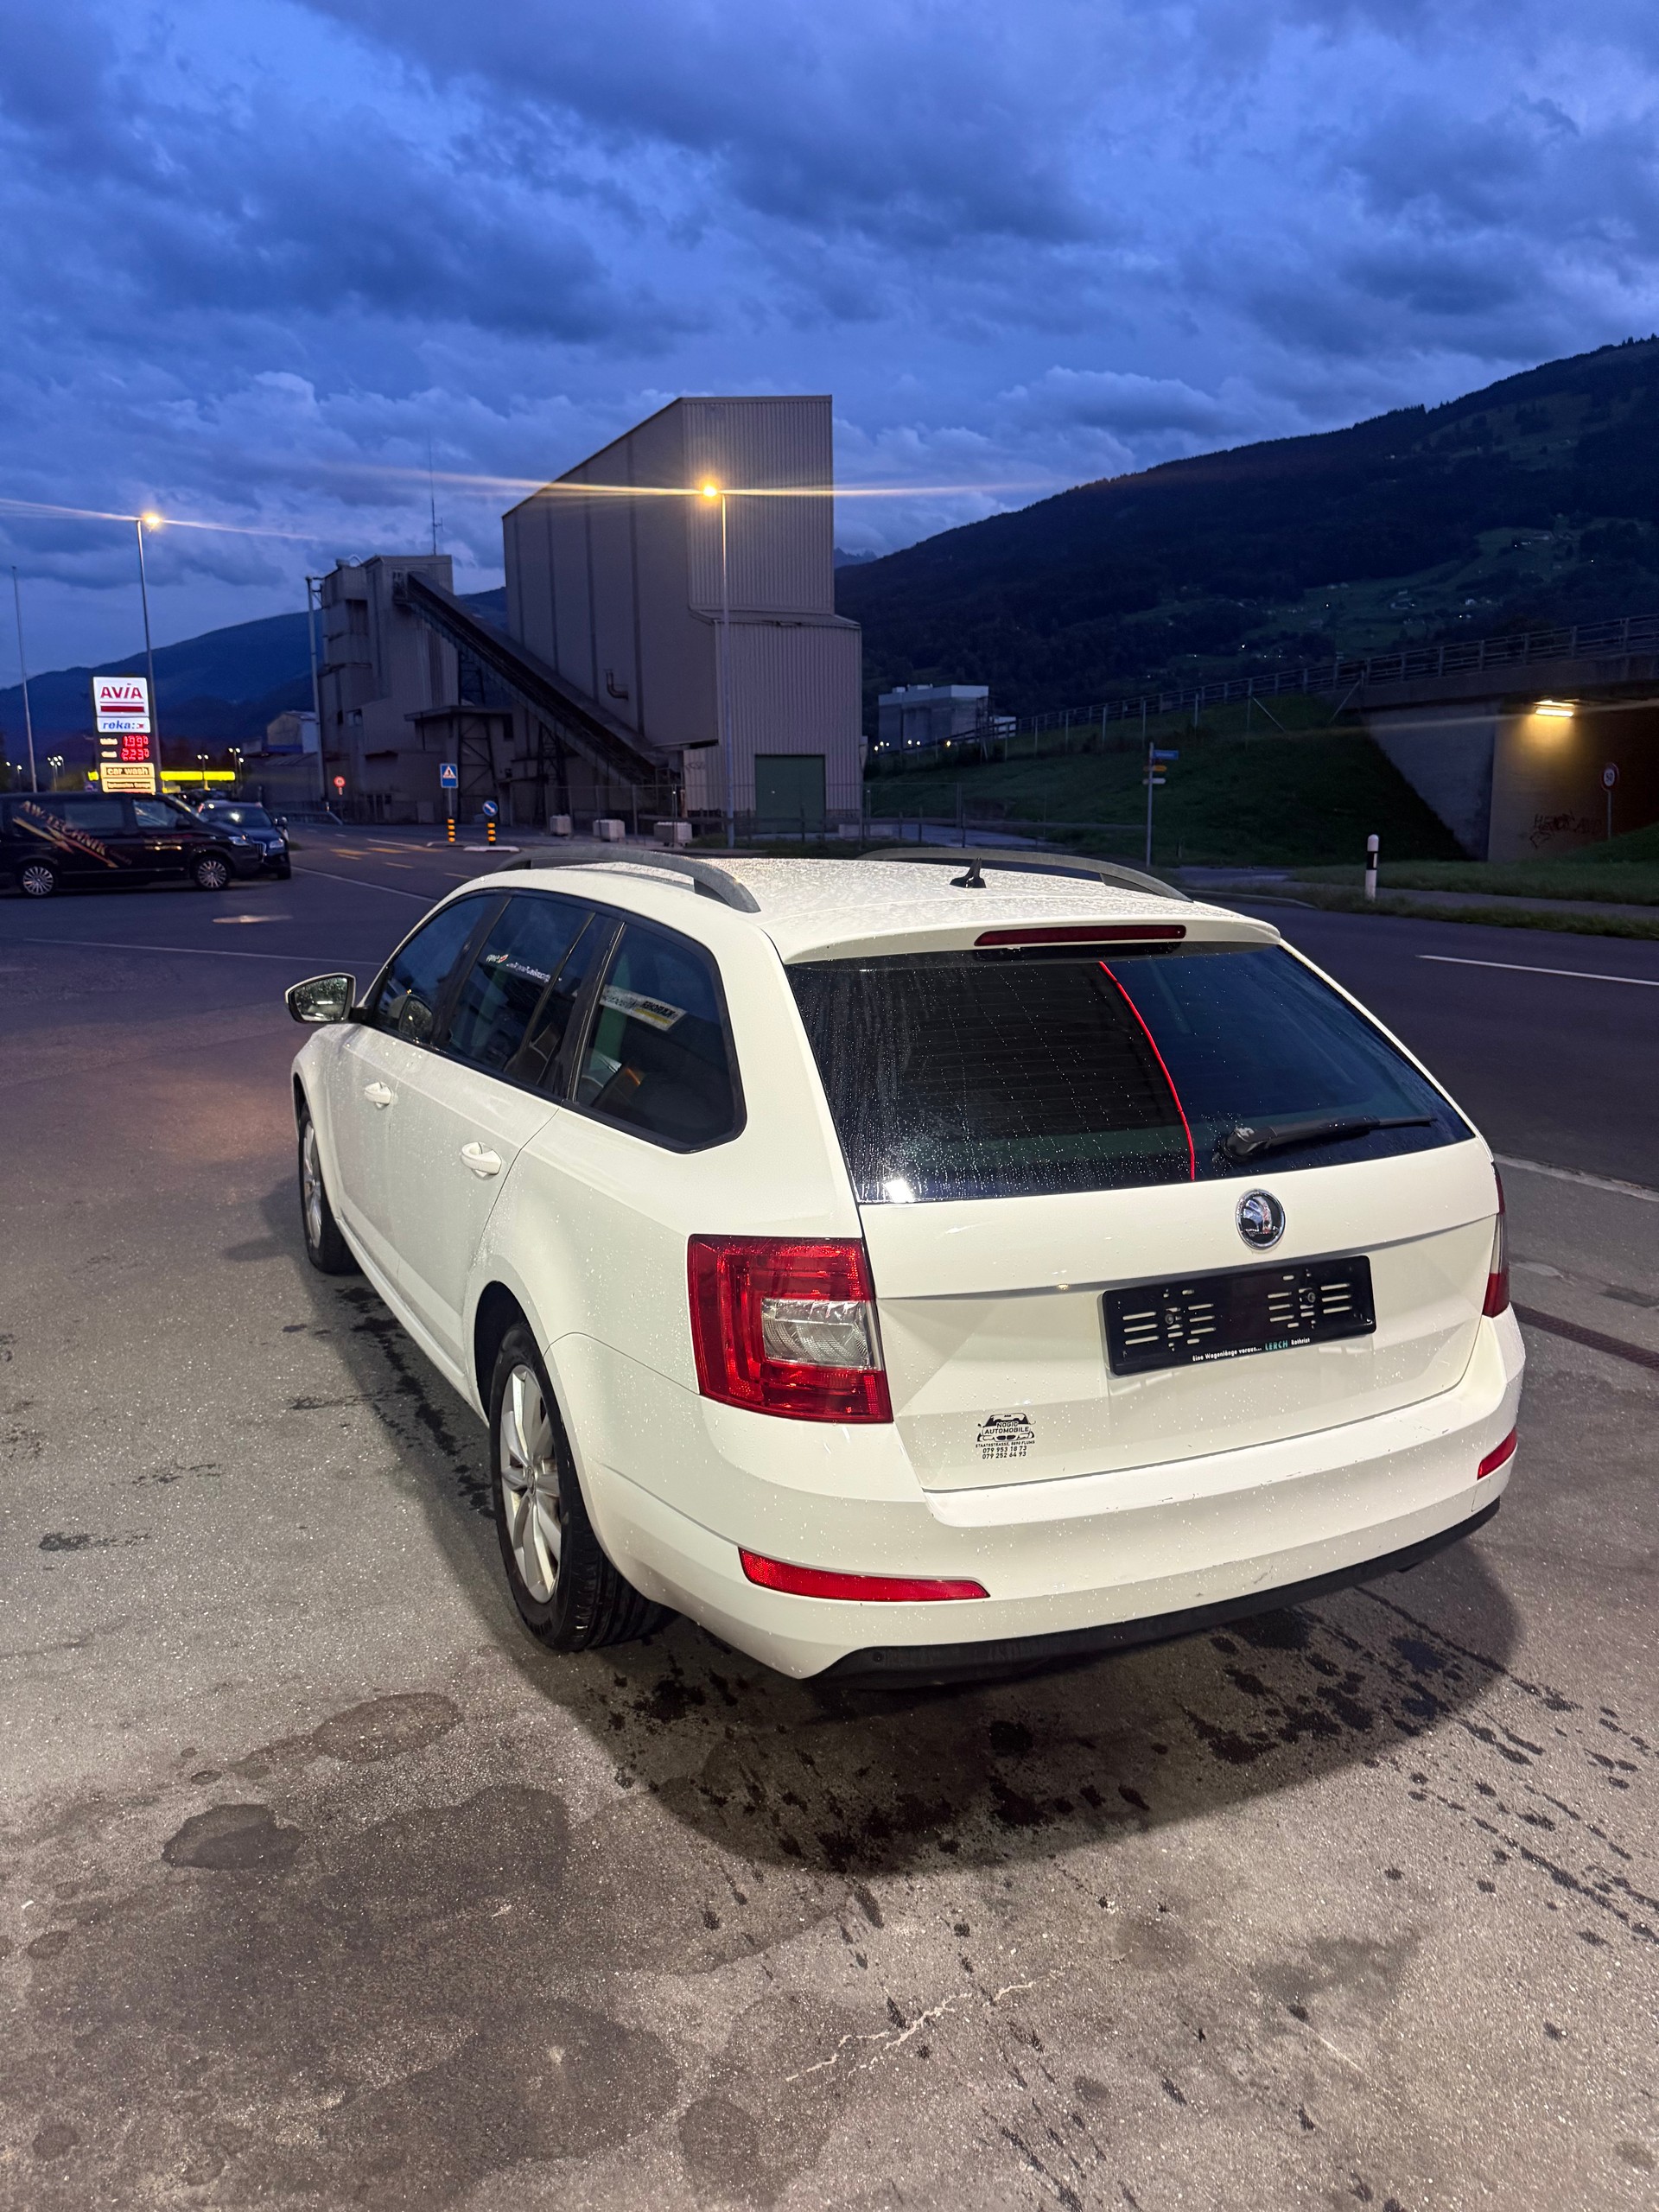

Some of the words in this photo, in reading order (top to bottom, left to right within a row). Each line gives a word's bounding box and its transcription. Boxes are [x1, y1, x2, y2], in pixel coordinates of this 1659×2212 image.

[100, 683, 144, 699] AVIA
[1205, 1351, 1237, 1360] Wagenlänge
[1265, 1340, 1288, 1351] LERCH
[1291, 1338, 1311, 1346] Rothrist
